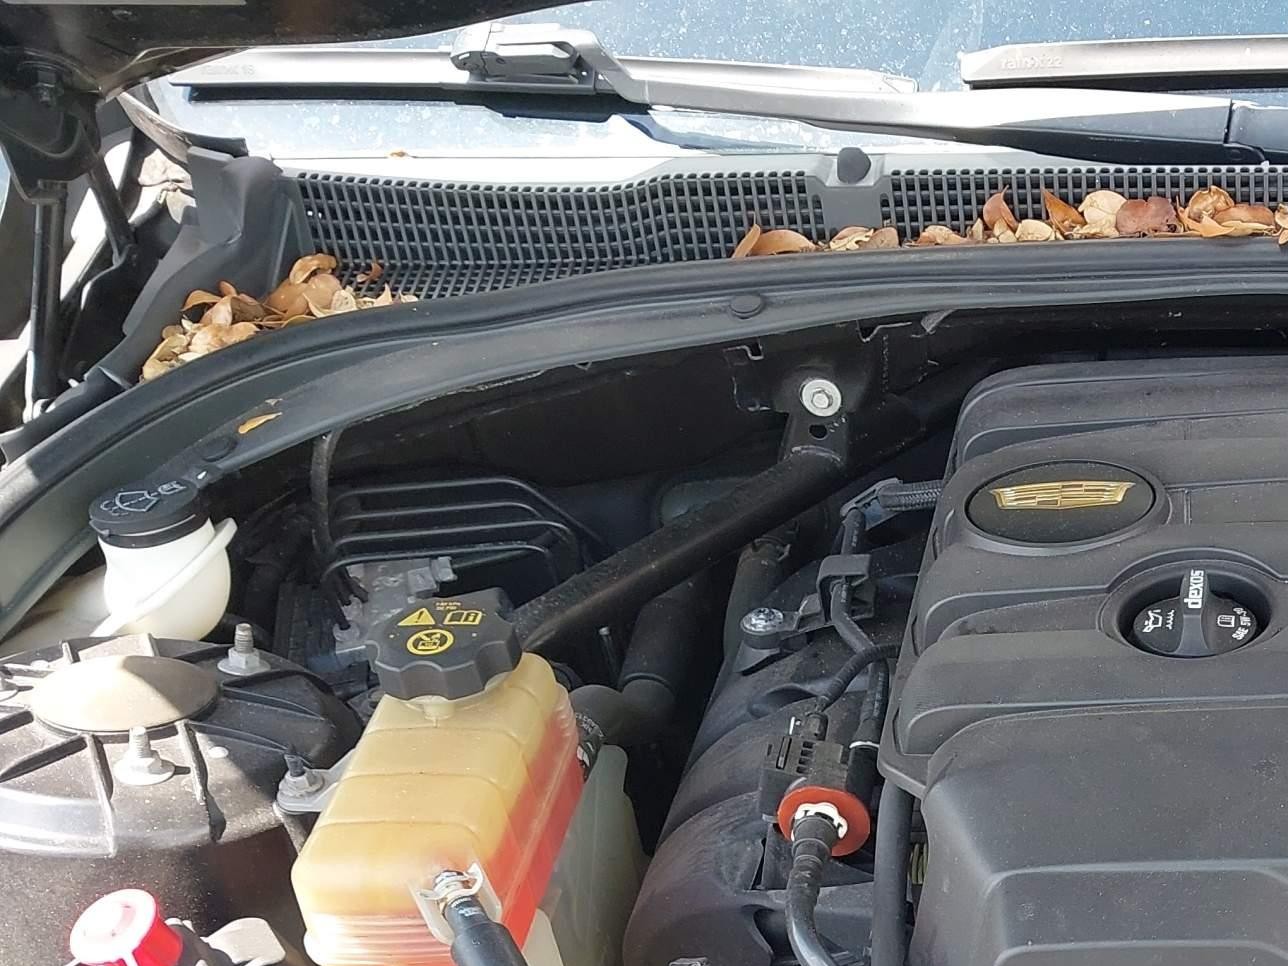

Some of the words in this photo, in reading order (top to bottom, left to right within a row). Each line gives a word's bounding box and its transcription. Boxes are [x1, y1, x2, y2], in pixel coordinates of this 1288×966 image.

[1183, 568, 1205, 609] dexos
[1232, 607, 1252, 627] 5W-30
[1231, 626, 1249, 640] SAE
